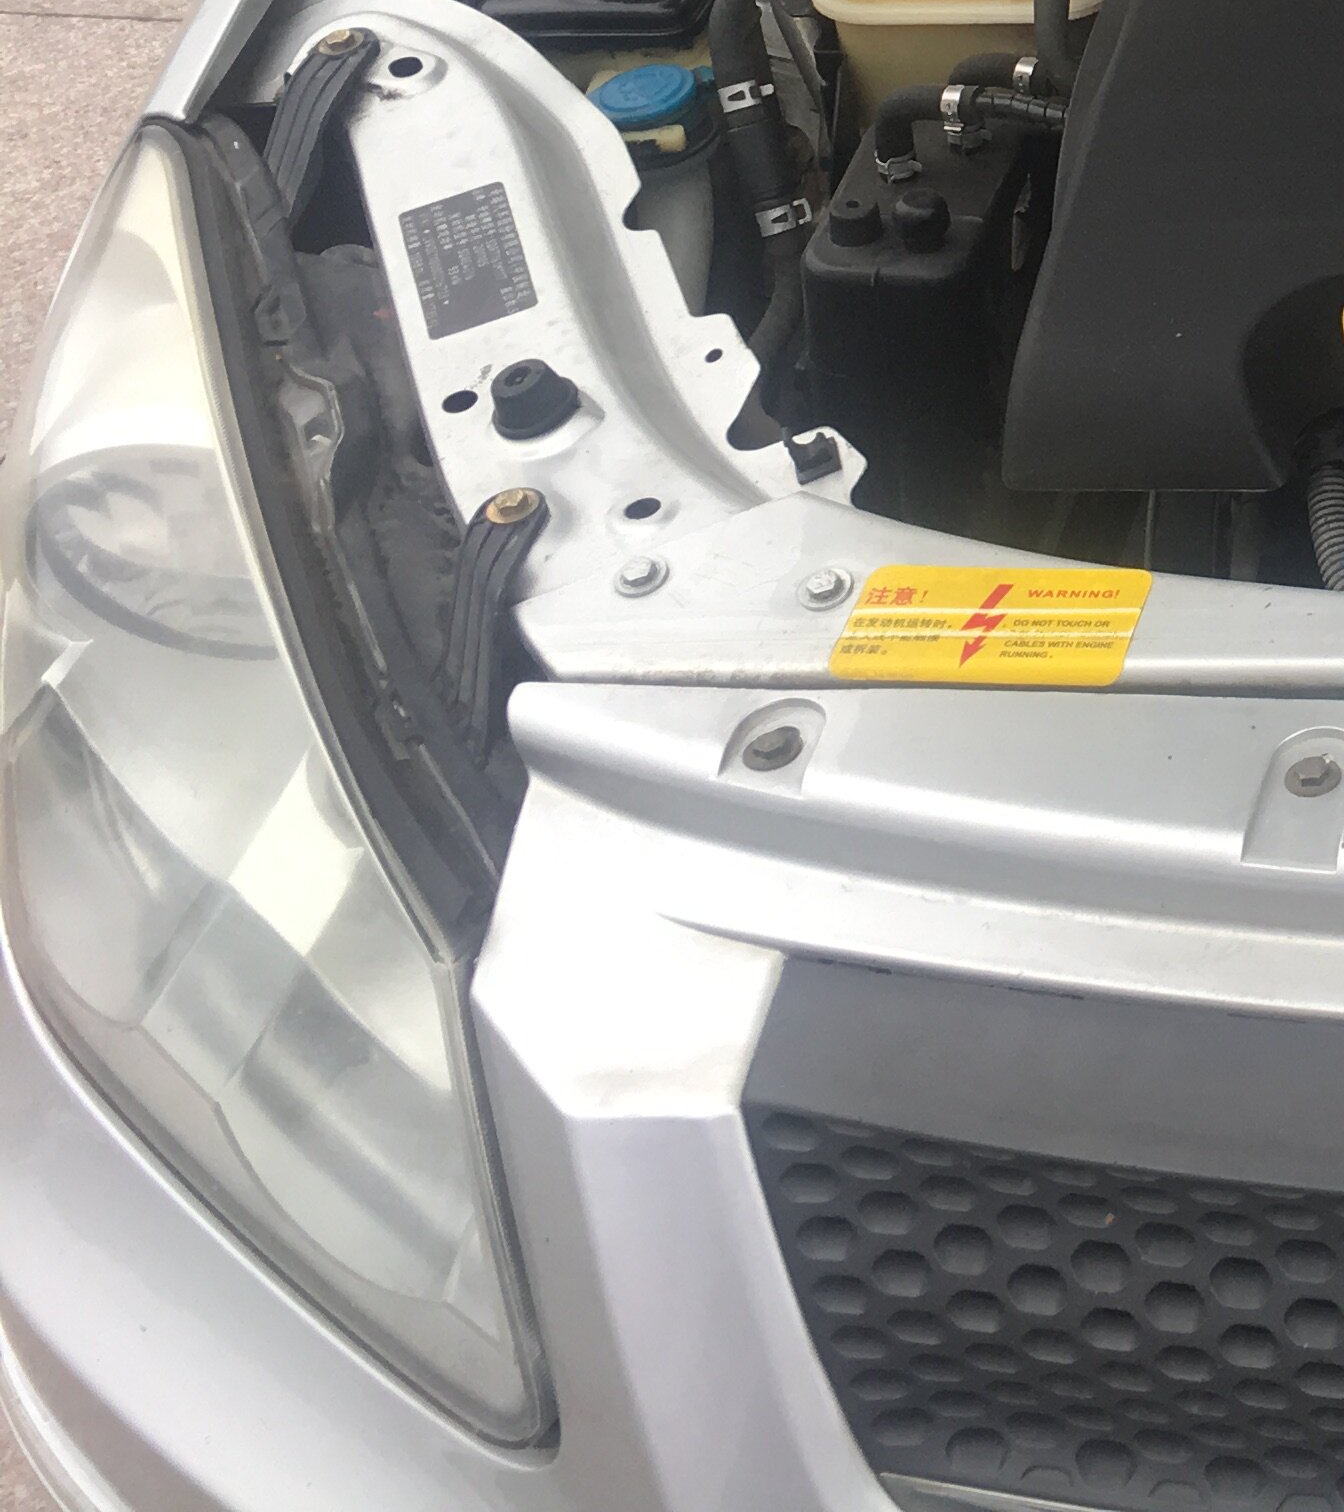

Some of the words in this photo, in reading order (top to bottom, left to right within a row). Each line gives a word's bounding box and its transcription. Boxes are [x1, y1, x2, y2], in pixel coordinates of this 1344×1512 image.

[1027, 589, 1121, 600] WARNING!
[1031, 619, 1054, 628] NOT
[1056, 619, 1092, 628] TOUCH
[1003, 639, 1046, 648] CABLES
[1047, 640, 1073, 649] WITH
[1075, 640, 1115, 649] ENGINE
